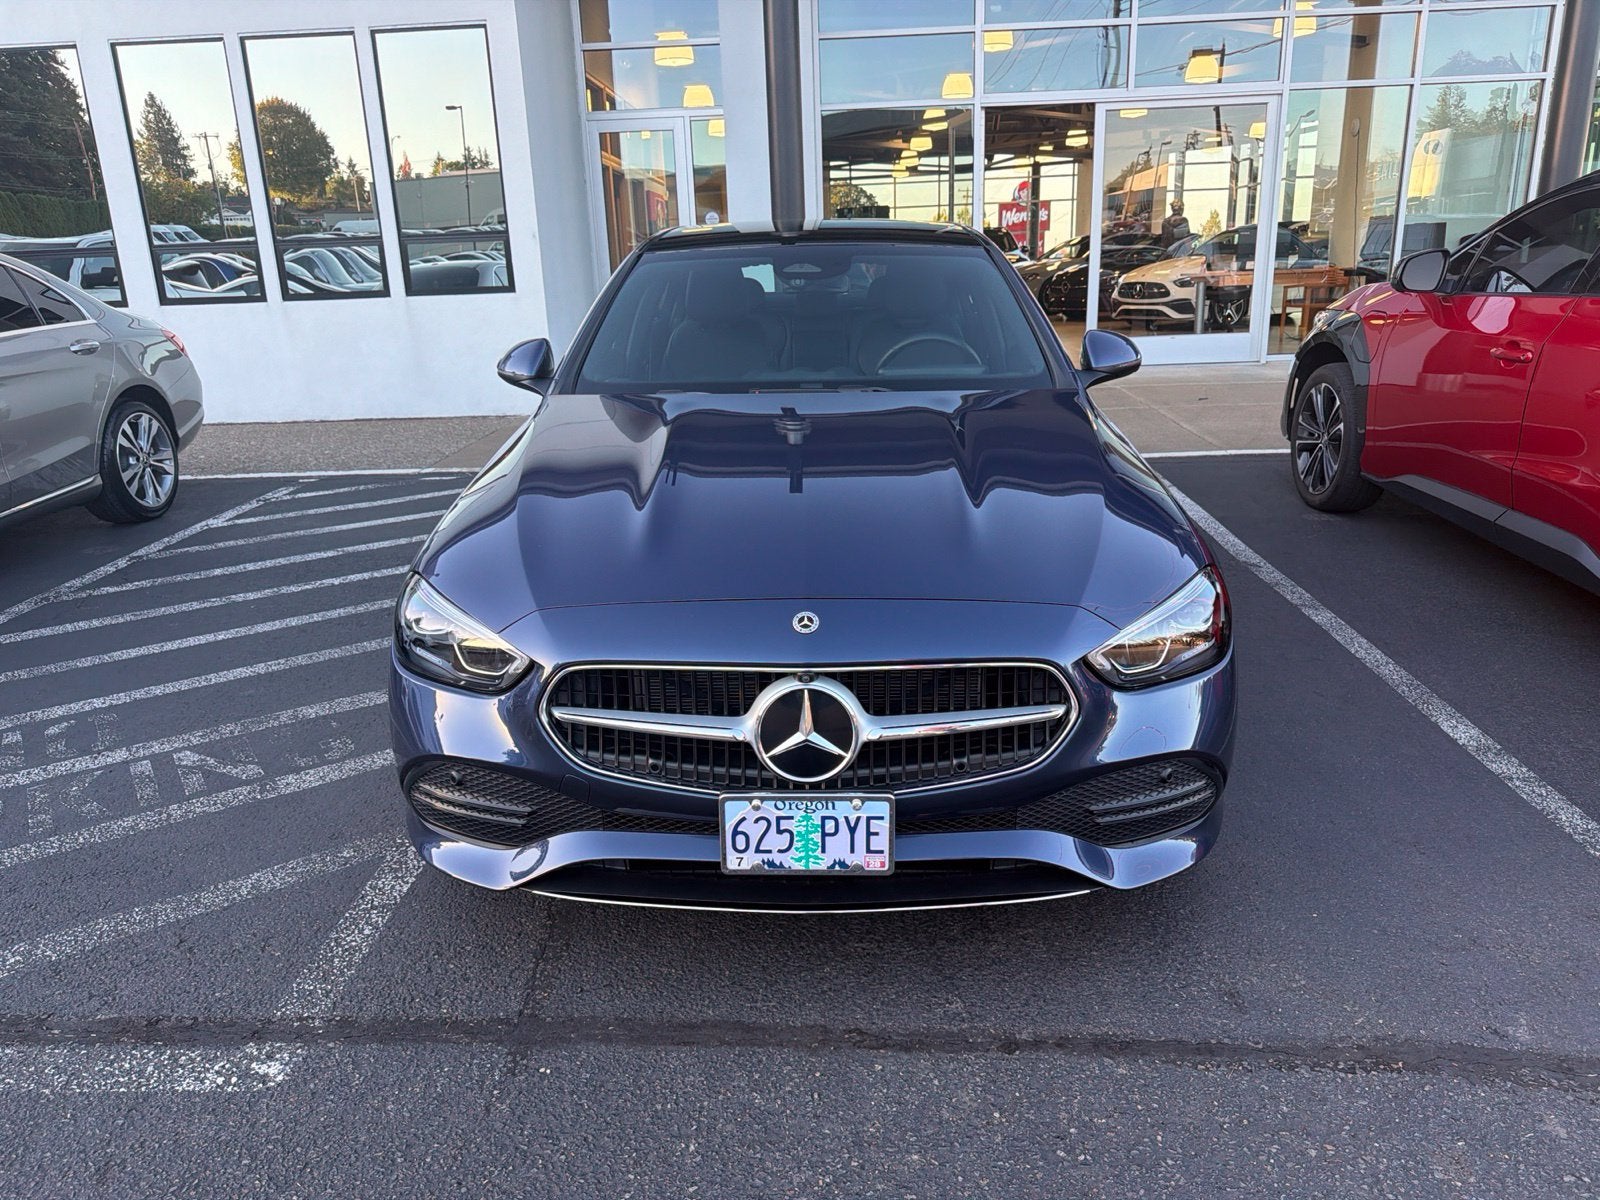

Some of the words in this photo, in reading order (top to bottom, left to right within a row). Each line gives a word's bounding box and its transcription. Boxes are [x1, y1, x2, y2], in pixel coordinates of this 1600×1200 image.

[1002, 207, 1049, 227] Wen's
[774, 800, 837, 813] Oregon
[731, 816, 795, 854] 625
[820, 816, 885, 854] PYE
[735, 857, 744, 867] 7
